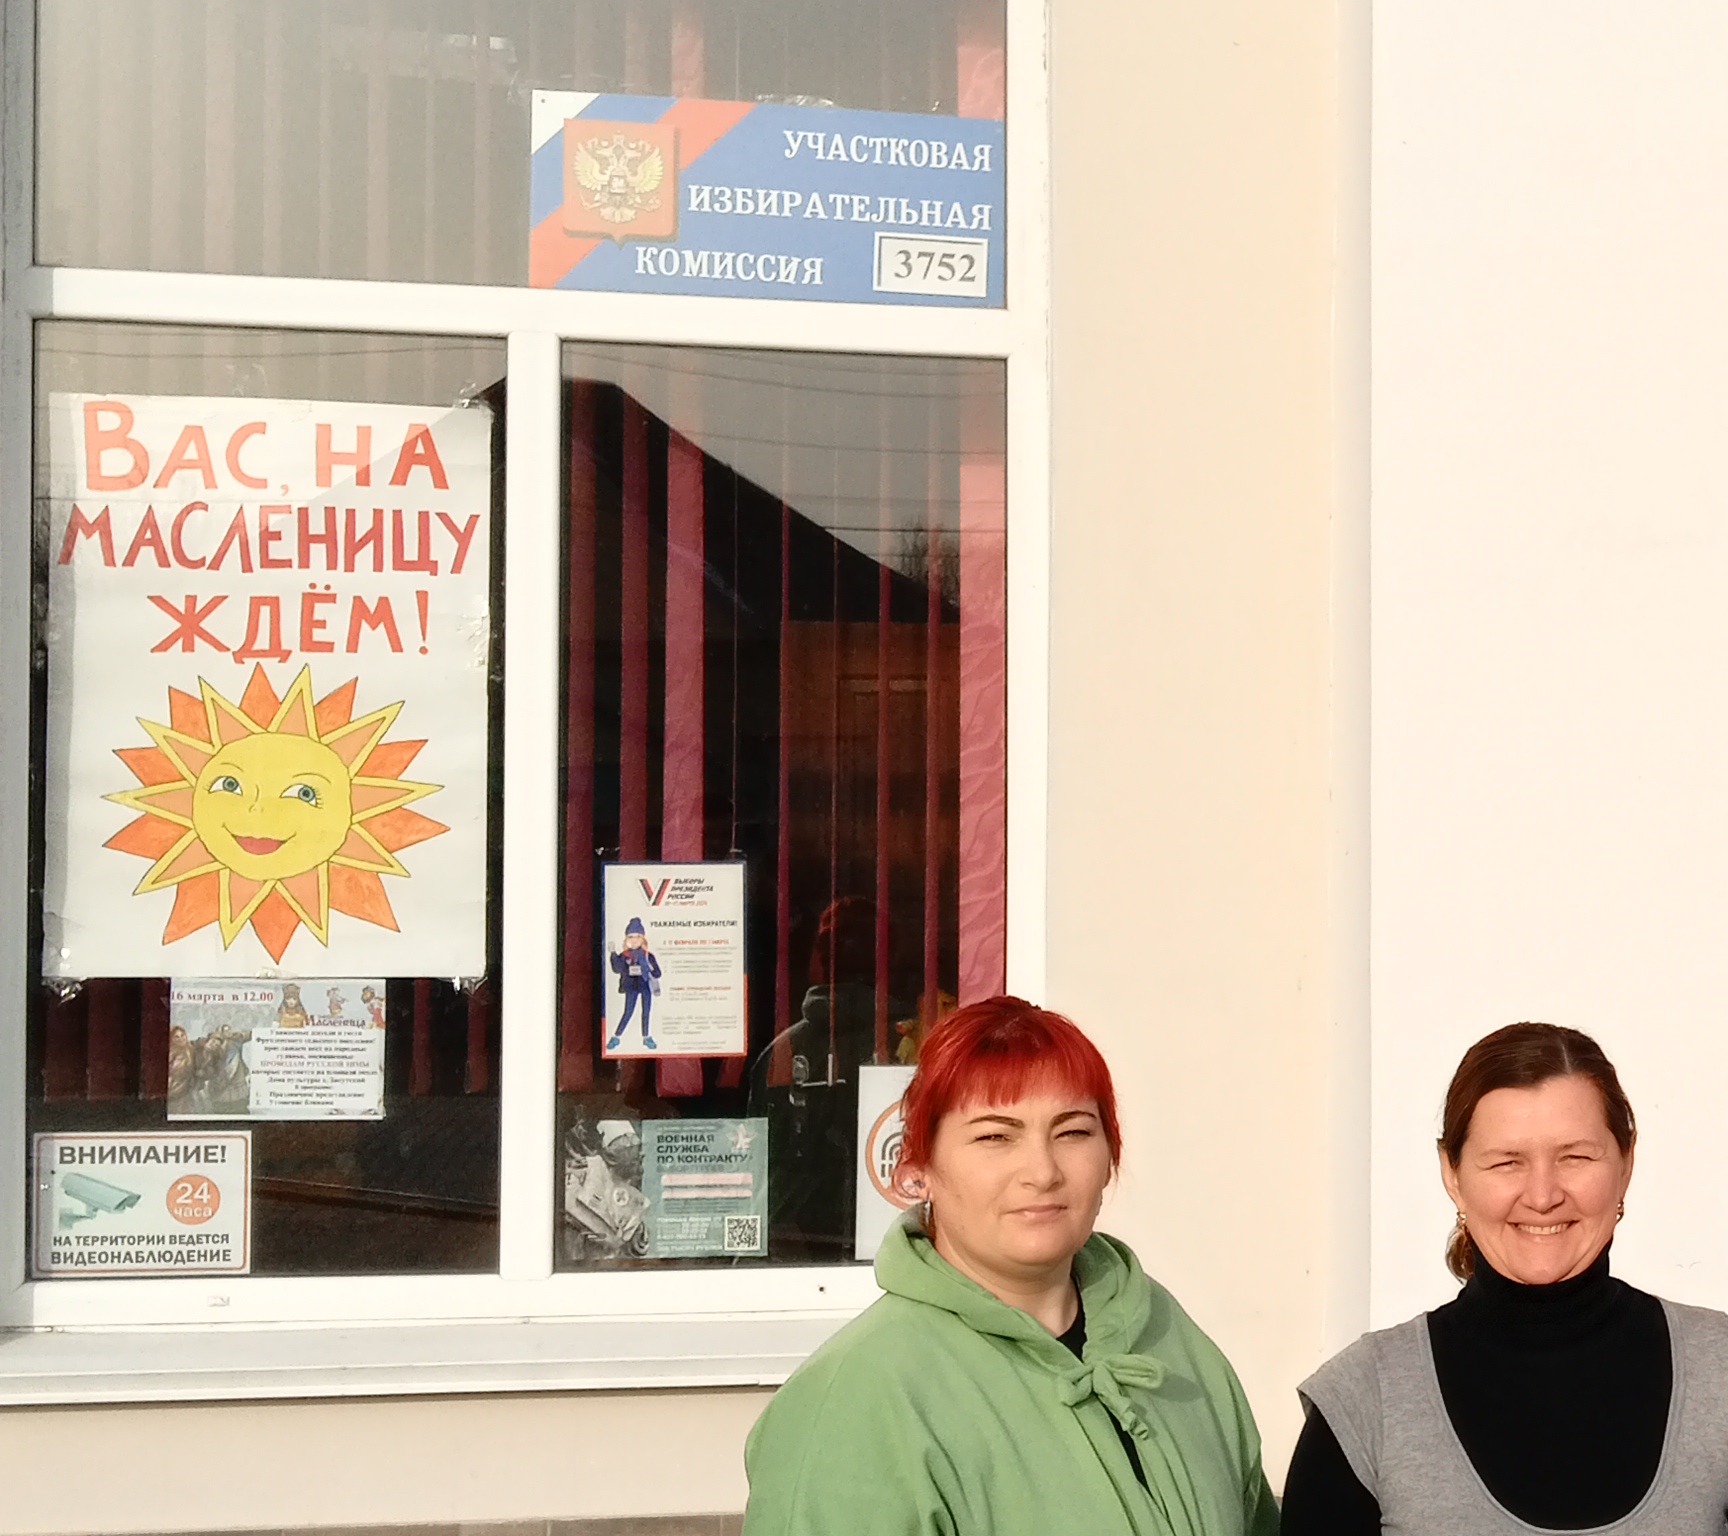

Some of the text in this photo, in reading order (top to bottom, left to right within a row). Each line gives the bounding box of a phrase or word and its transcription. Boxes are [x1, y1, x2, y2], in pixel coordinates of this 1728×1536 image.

[783, 130, 993, 173] УЧАСТКОВАЯ
[687, 184, 992, 231] ИЗБИРАТЕЛЬНАЯ
[635, 246, 823, 285] КОМИССИЯ
[894, 250, 977, 283] 3752
[315, 422, 450, 491] НА
[58, 502, 481, 576] МАСЛЕНИЦУ
[147, 582, 430, 664] ЖДЁМ!
[171, 991, 274, 1004] 16 марта в 12.00
[657, 1134, 714, 1143] ВОЕННАЯ
[657, 1144, 709, 1153] СЛУЖБА
[59, 1145, 227, 1165] ВНИМАНИЕ!
[657, 1154, 748, 1163] ПО КОНТРАКТУ
[175, 1182, 210, 1204] 24
[174, 1207, 212, 1218] часа
[53, 1233, 230, 1246] НА ТЕРРИТОРИИ ВЕДЕТСЯ
[51, 1249, 231, 1266] ВИДЕОНАБЛЮДЕНИЕ
